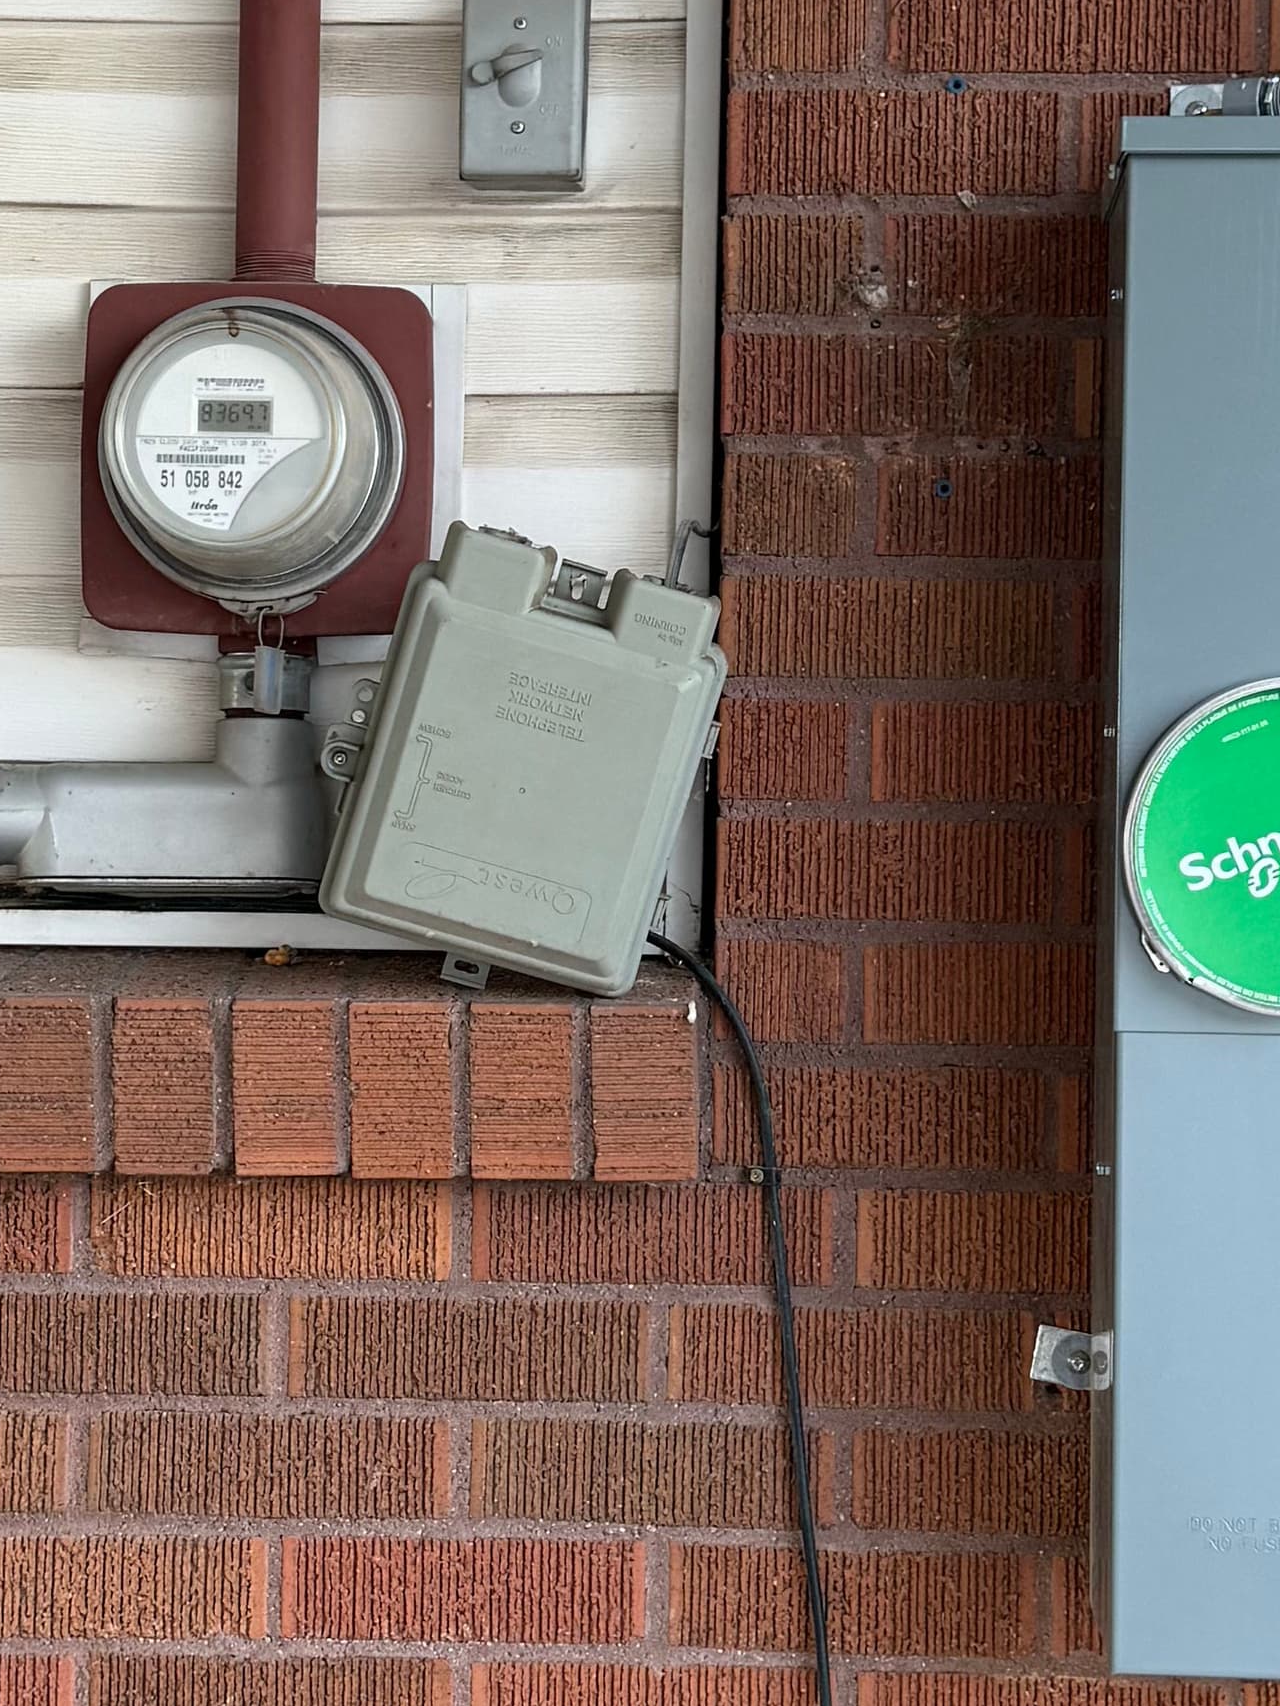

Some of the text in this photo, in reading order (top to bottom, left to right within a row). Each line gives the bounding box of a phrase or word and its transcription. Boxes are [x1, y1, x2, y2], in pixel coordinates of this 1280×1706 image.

[201, 403, 269, 424] 83697
[160, 469, 243, 489] 51 058 842
[634, 613, 687, 636] CORNING
[508, 671, 592, 707] INTERFACE
[507, 689, 584, 722] NETWORK
[495, 705, 585, 743] TELEPHONE
[478, 867, 575, 915] Qwest
[1190, 1516, 1213, 1533] DO
[1222, 1517, 1257, 1533] NOT
[1208, 1536, 1232, 1553] NO
